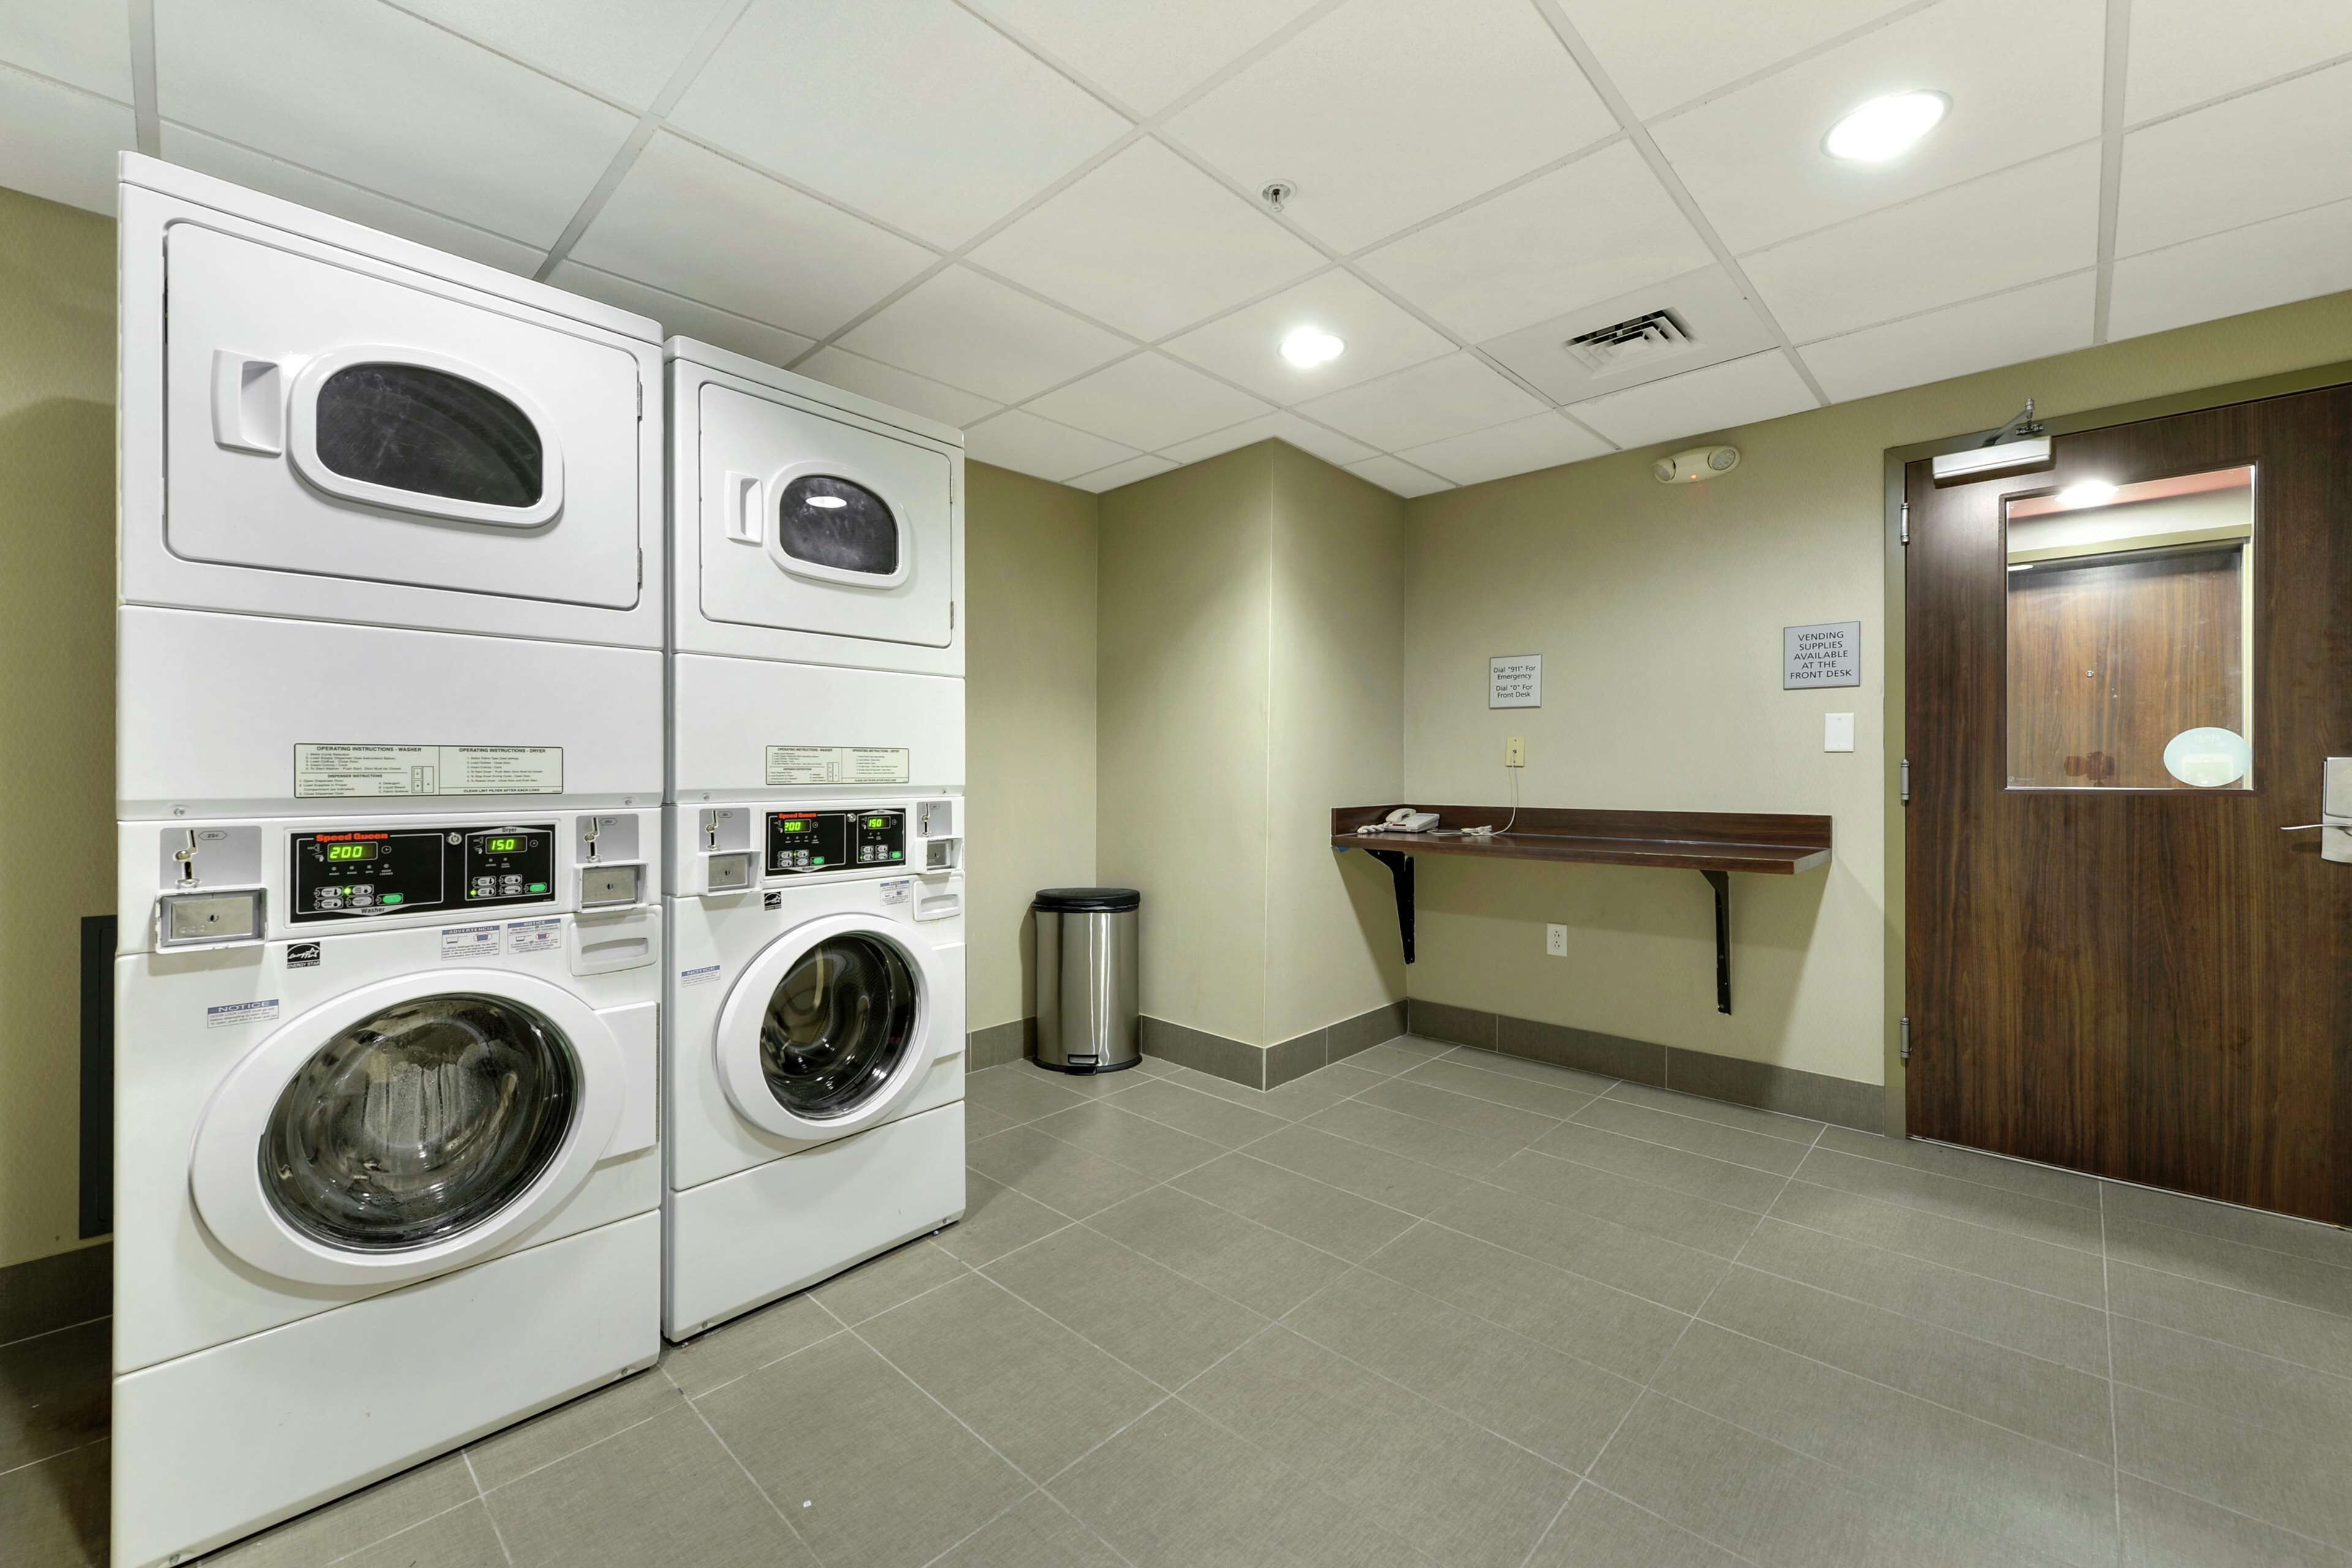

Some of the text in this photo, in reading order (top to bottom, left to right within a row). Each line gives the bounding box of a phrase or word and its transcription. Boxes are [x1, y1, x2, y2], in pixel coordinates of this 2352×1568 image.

[1798, 631, 1844, 641] VENDING
[1800, 641, 1842, 650] SUPPLIES
[1794, 650, 1848, 660] AVAILABLE
[1826, 669, 1852, 677] DESK
[869, 818, 882, 827] 150
[316, 834, 352, 842] Speed
[491, 840, 514, 850] 150
[330, 846, 363, 859] 200
[218, 1001, 270, 1012] NOTICE
